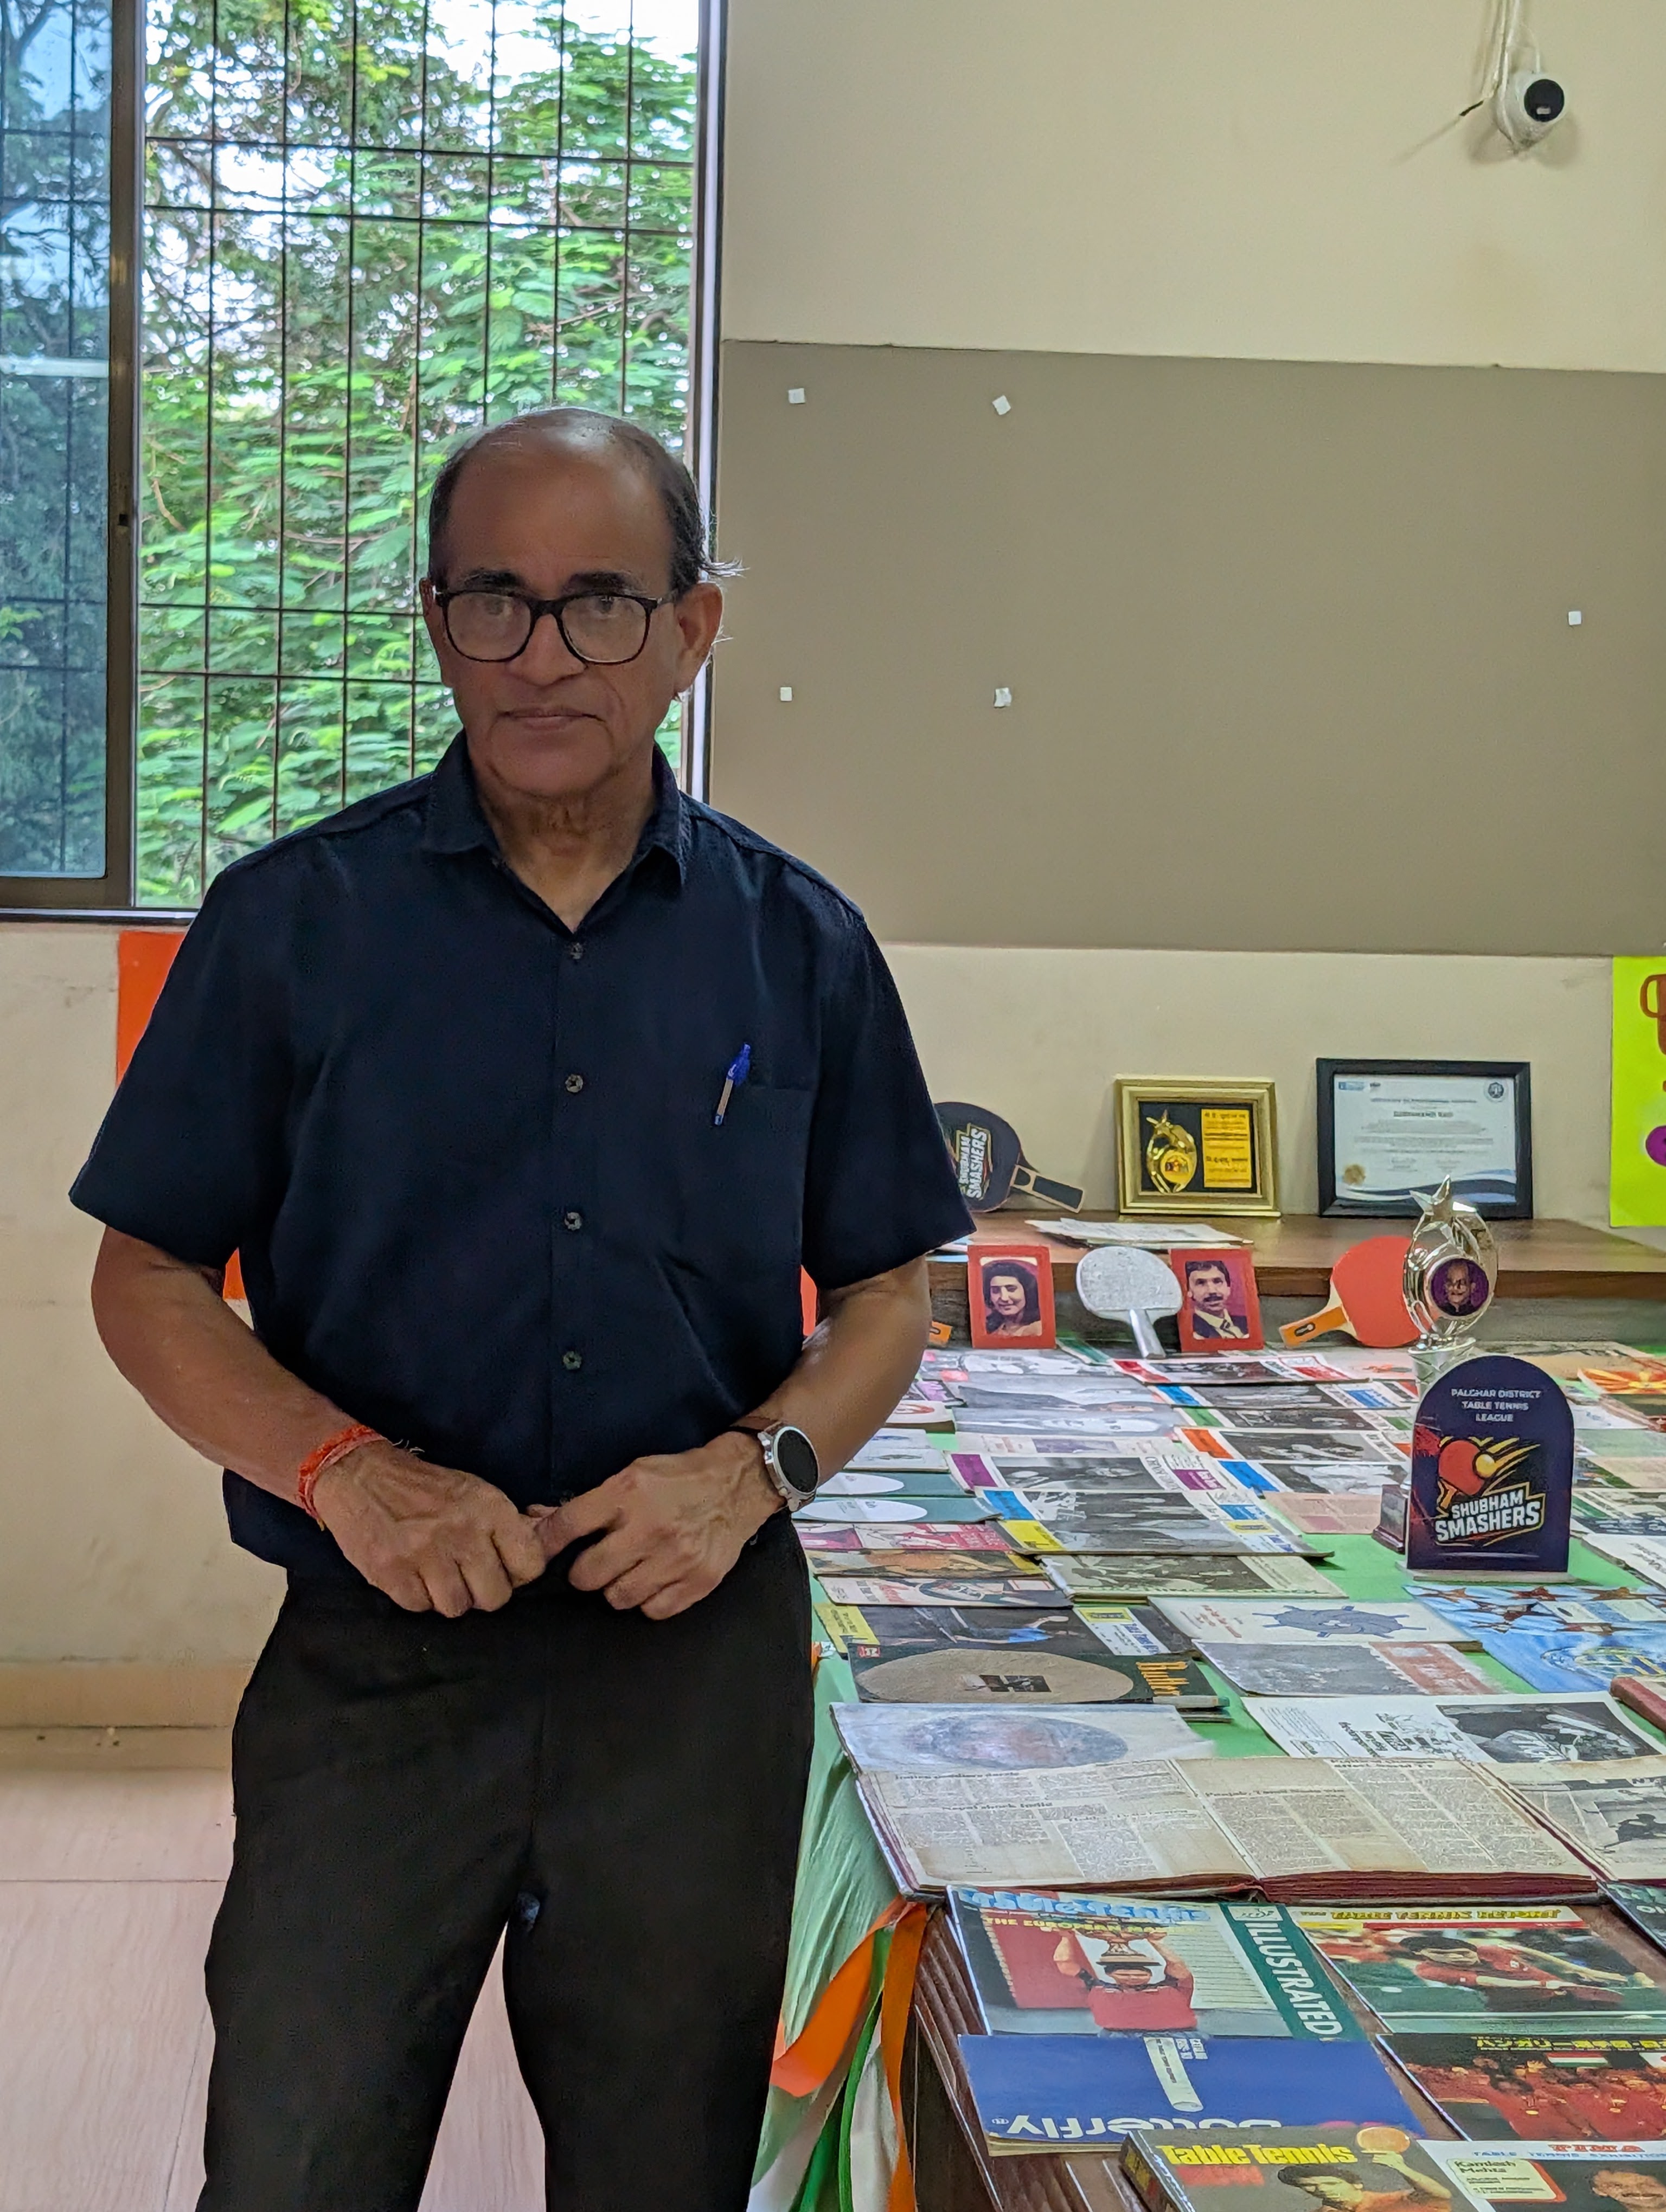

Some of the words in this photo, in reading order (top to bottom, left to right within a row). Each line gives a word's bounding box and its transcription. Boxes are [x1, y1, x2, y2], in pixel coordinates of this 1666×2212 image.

[966, 1128, 987, 1198] SMASHERS
[1451, 1388, 1495, 1397] PALGHAR
[1498, 1390, 1542, 1398] DISTRICT
[1462, 1400, 1491, 1410] TABLE
[1495, 1401, 1529, 1410] TENNIS
[1476, 1413, 1514, 1422] LEAGUE
[1451, 1489, 1524, 1519] SHUBHAM
[1436, 1501, 1541, 1541] SMASHERS
[984, 1918, 1018, 1927] THE
[1245, 1922, 1343, 2035] ILLUSTRATED
[1155, 2144, 1250, 2165] Table
[1249, 2143, 1357, 2164] Tennis
